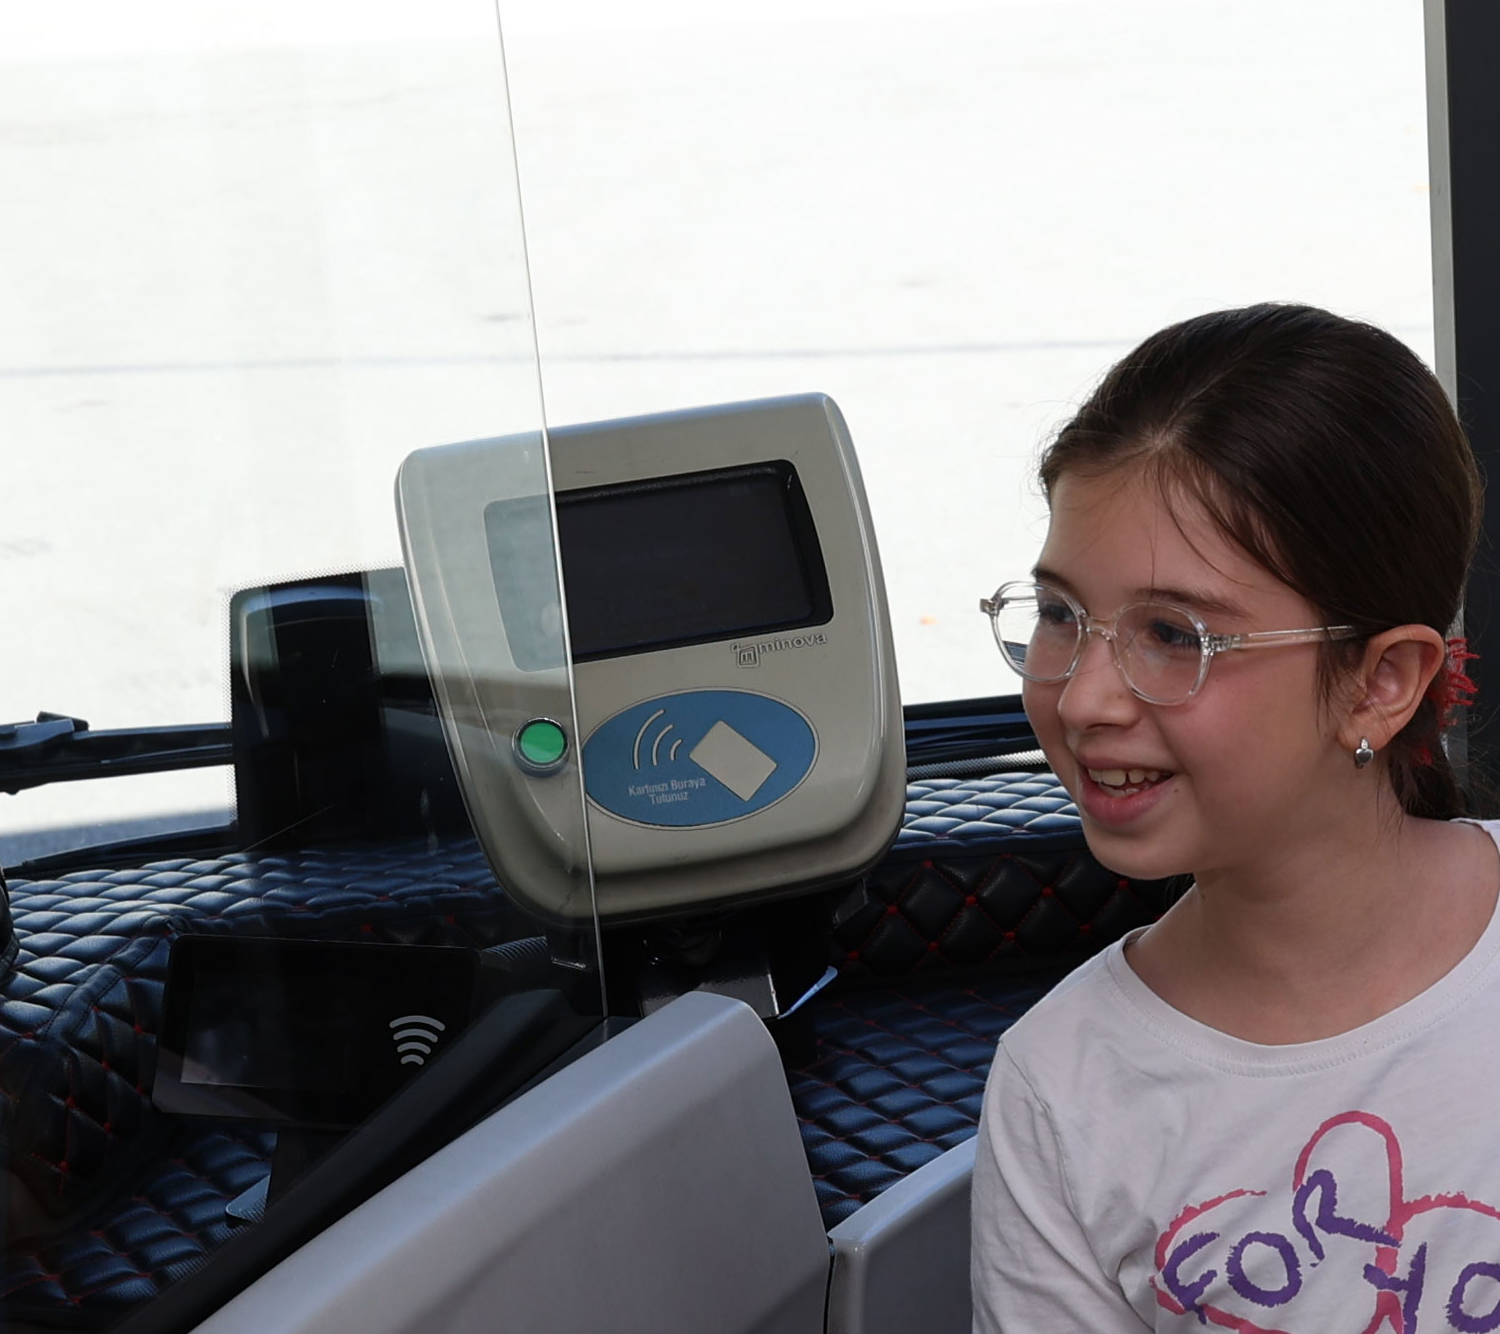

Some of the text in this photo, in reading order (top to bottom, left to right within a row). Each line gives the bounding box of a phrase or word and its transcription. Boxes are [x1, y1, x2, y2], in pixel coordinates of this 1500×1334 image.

[759, 634, 827, 654] minova
[671, 778, 706, 790] Buraya
[649, 791, 689, 805] Tutunuz
[1163, 1169, 1400, 1324] FOR
